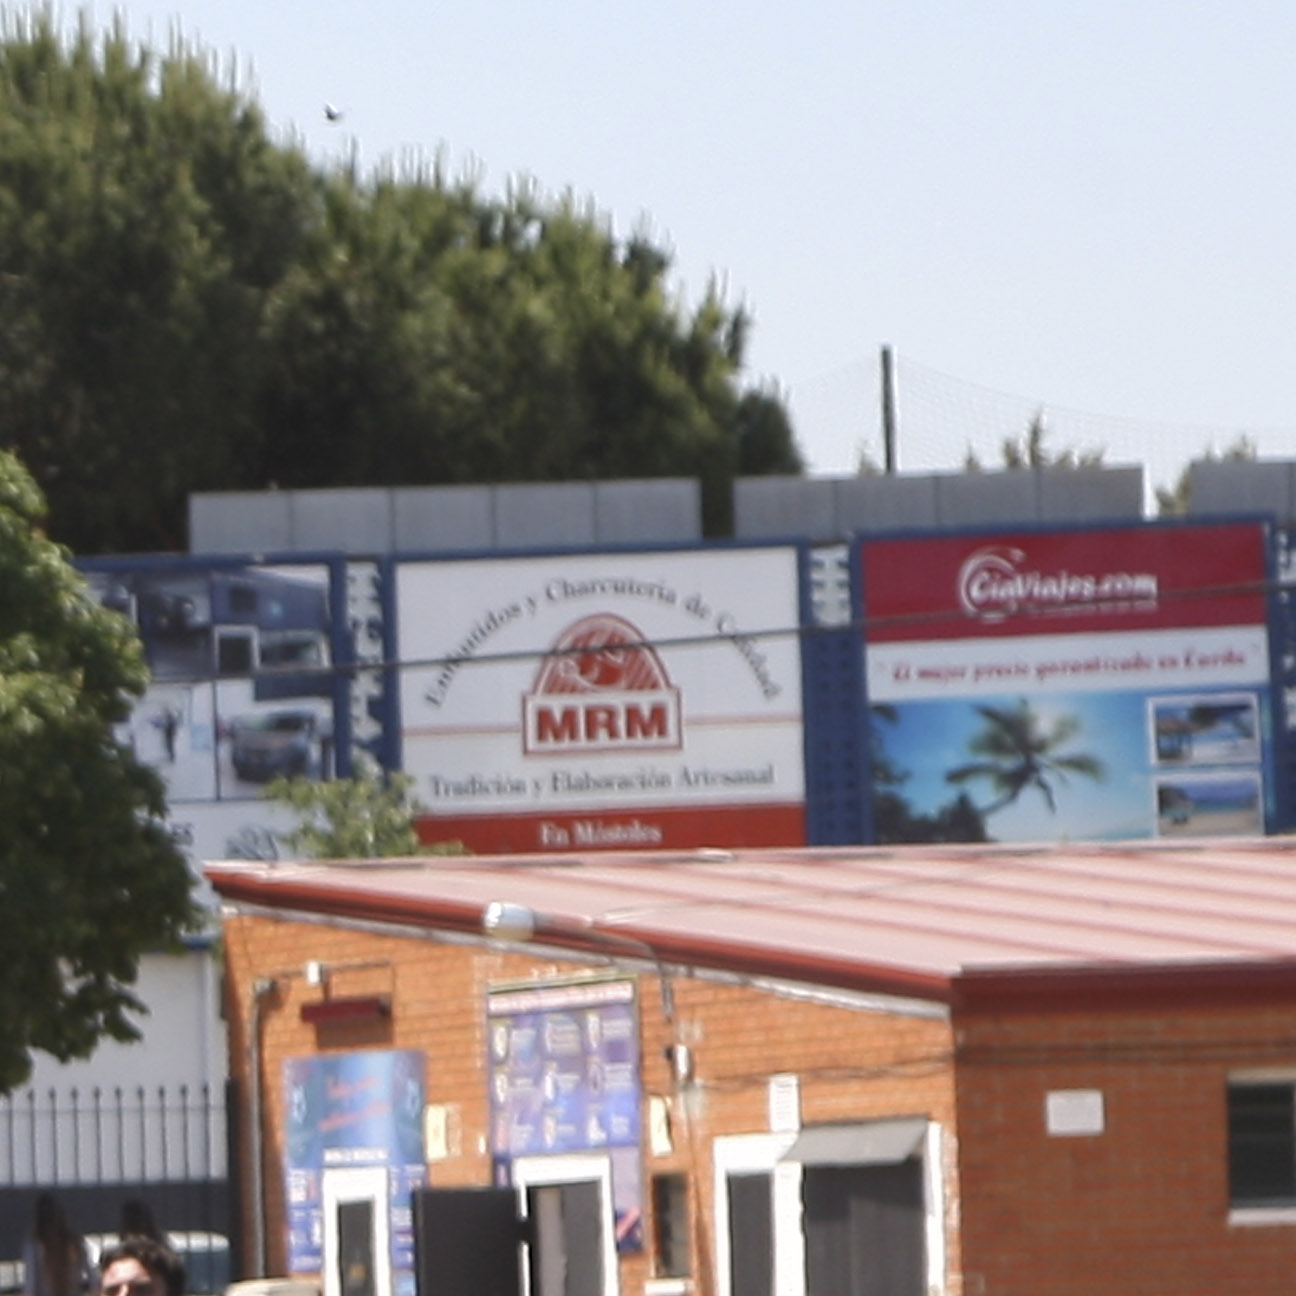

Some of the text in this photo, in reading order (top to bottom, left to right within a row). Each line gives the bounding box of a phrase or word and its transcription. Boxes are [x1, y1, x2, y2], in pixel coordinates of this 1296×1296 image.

[536, 702, 669, 743] MRM
[551, 767, 673, 794] Elaboración
[678, 763, 776, 788] Artesanal
